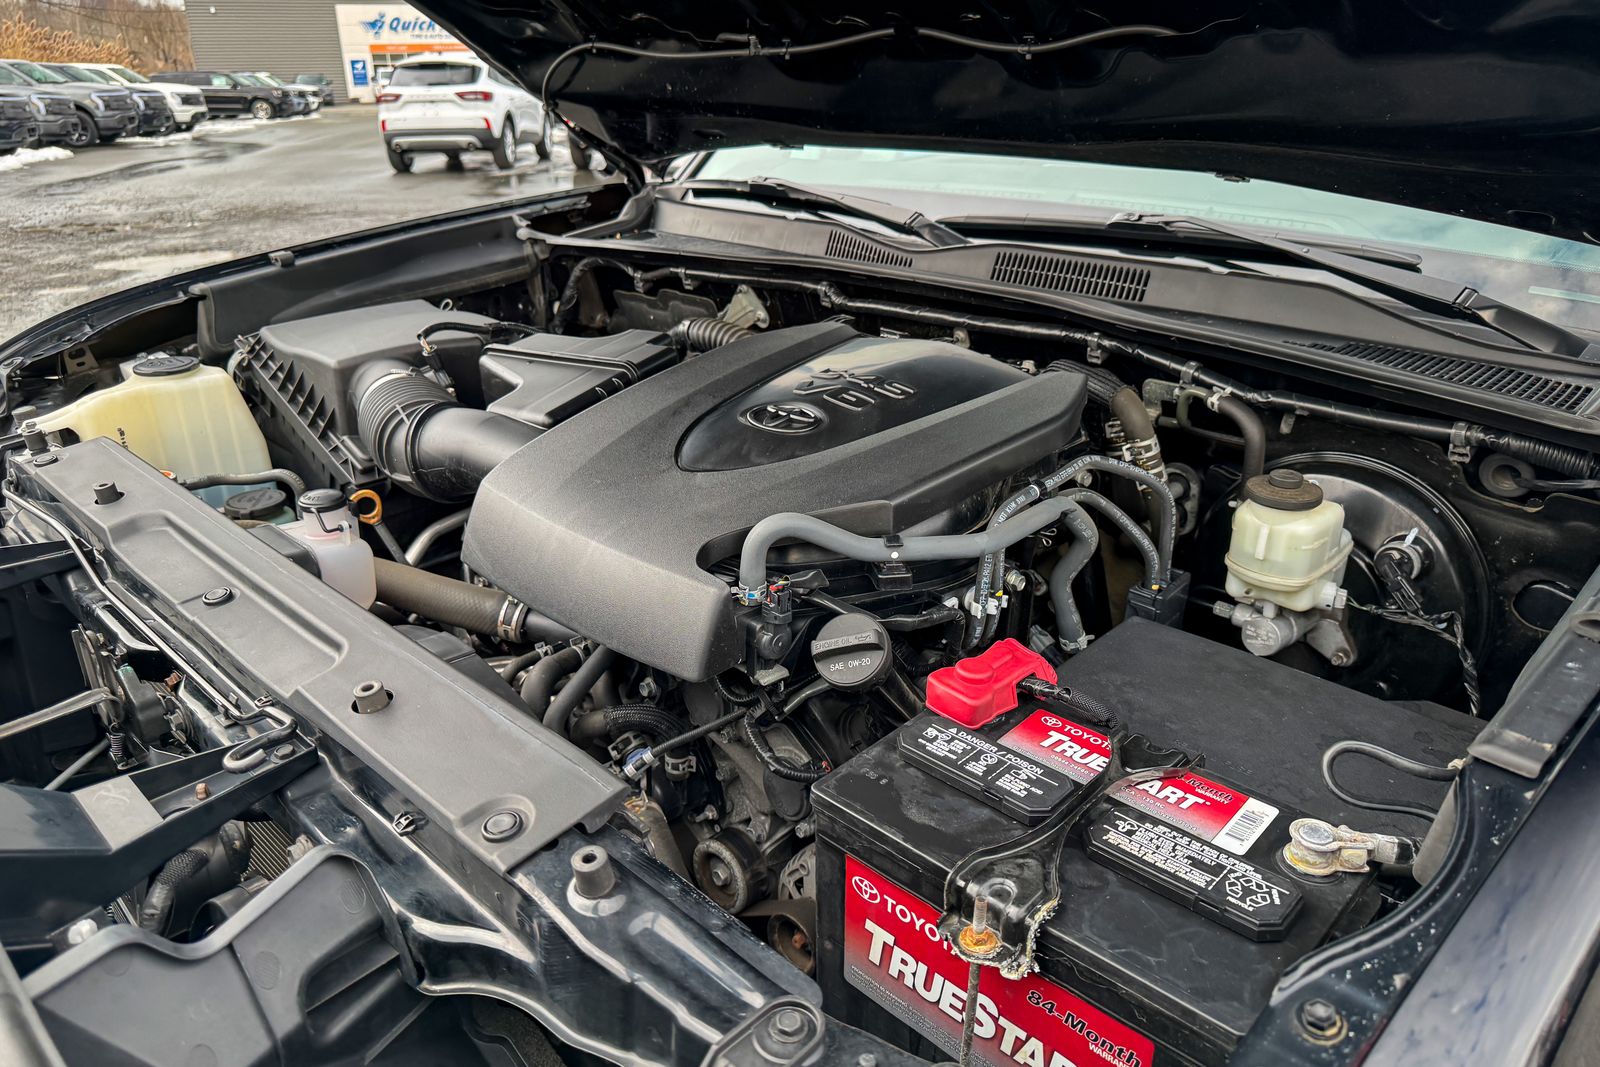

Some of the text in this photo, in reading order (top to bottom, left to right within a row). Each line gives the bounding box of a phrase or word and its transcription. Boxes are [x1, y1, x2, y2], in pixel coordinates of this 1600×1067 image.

[389, 17, 436, 32] Quick
[814, 640, 840, 651] ENGINE
[830, 657, 871, 671] SAE 0W-20
[956, 731, 998, 752] DANGER
[1004, 753, 1044, 774] POISON
[1194, 788, 1230, 804] WARRANTY
[1134, 831, 1151, 840] WITH
[1137, 827, 1159, 838] FLUSH
[1174, 844, 1216, 865] IMMEDIATELY
[1130, 834, 1192, 864] MEDICAL HELP FAST
[883, 894, 958, 956] TOYO
[1026, 990, 1142, 1067] 84-Month
